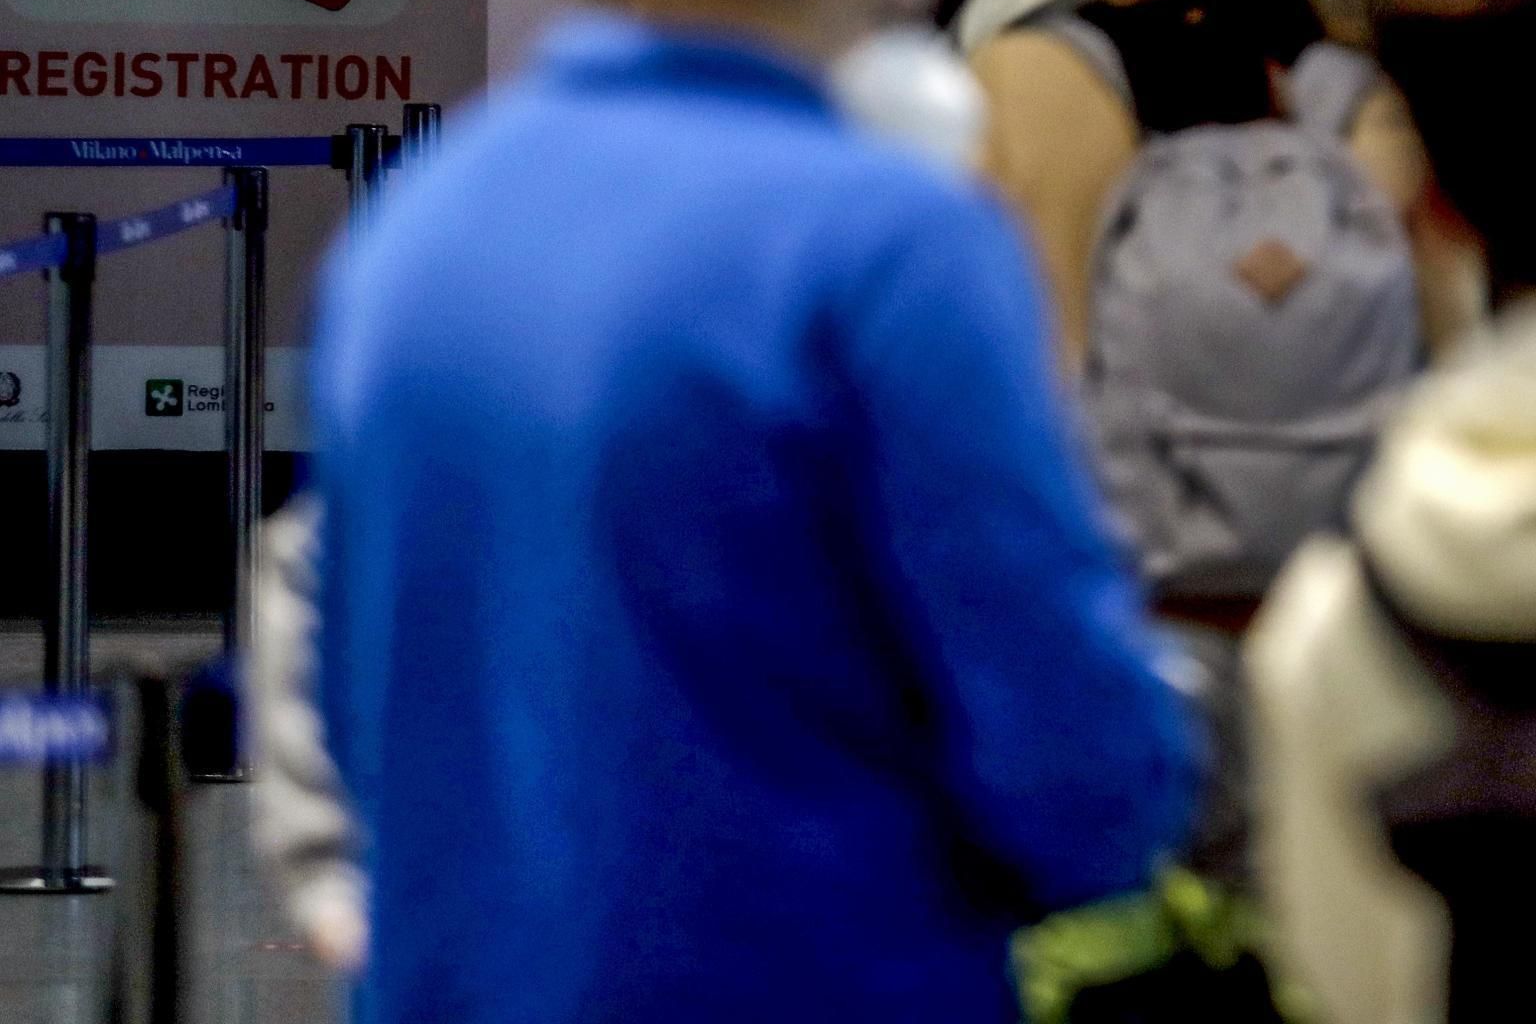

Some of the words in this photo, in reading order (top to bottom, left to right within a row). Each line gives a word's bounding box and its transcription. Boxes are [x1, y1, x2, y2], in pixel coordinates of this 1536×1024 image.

[0, 51, 412, 101] REGISTRATION
[71, 140, 138, 160] Milano
[149, 140, 242, 164] Malpensa
[187, 384, 225, 400] Regi
